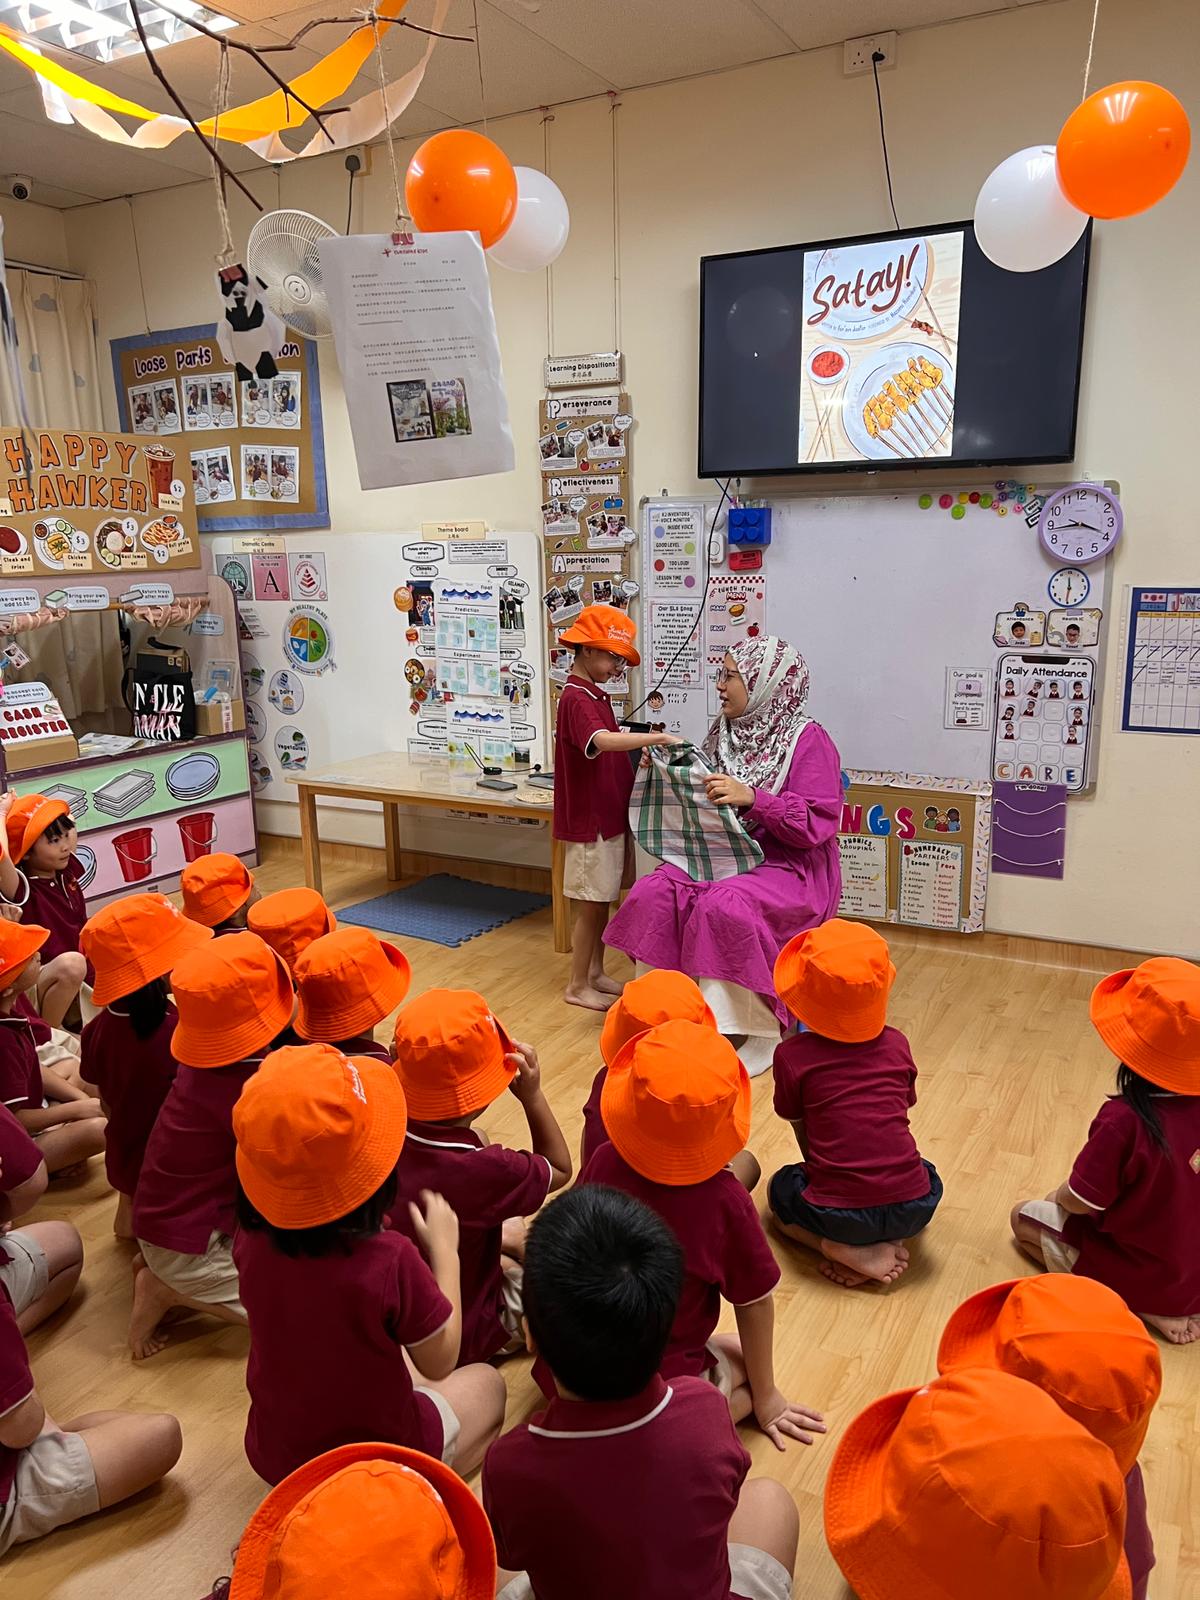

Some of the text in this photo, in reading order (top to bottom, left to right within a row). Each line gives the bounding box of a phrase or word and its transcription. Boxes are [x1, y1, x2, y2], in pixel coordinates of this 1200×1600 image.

[807, 244, 920, 326] Satay!
[135, 348, 211, 377] Loose Parts
[549, 361, 616, 372] Learning Dispositions
[549, 399, 612, 419] Perseverance
[4, 434, 136, 474] HAPPY
[550, 477, 614, 496] Reflectiveness
[8, 474, 147, 512] HAWKER
[1076, 490, 1087, 500] 12
[1095, 493, 1099, 503] 1
[1062, 495, 1071, 505] 11
[1051, 506, 1061, 516] 10
[1103, 503, 1111, 514] 2
[1047, 520, 1054, 531] 9
[1107, 517, 1114, 528] 3
[1051, 534, 1058, 544] 8
[1102, 532, 1110, 541] 4
[1061, 544, 1069, 554] 7
[1076, 547, 1083, 557] 6
[1091, 543, 1099, 553] 5
[554, 554, 610, 573] Appreciation
[264, 570, 280, 593] A
[726, 592, 747, 600] MENU
[1006, 666, 1088, 678] Daily Attendance
[3, 706, 42, 722] CASH
[0, 720, 68, 740] REGISTER
[839, 802, 917, 839] NGS
[839, 844, 876, 852] GROUPINGS
[913, 845, 951, 856] NUMERACY
[914, 853, 950, 861] PARTNERS
